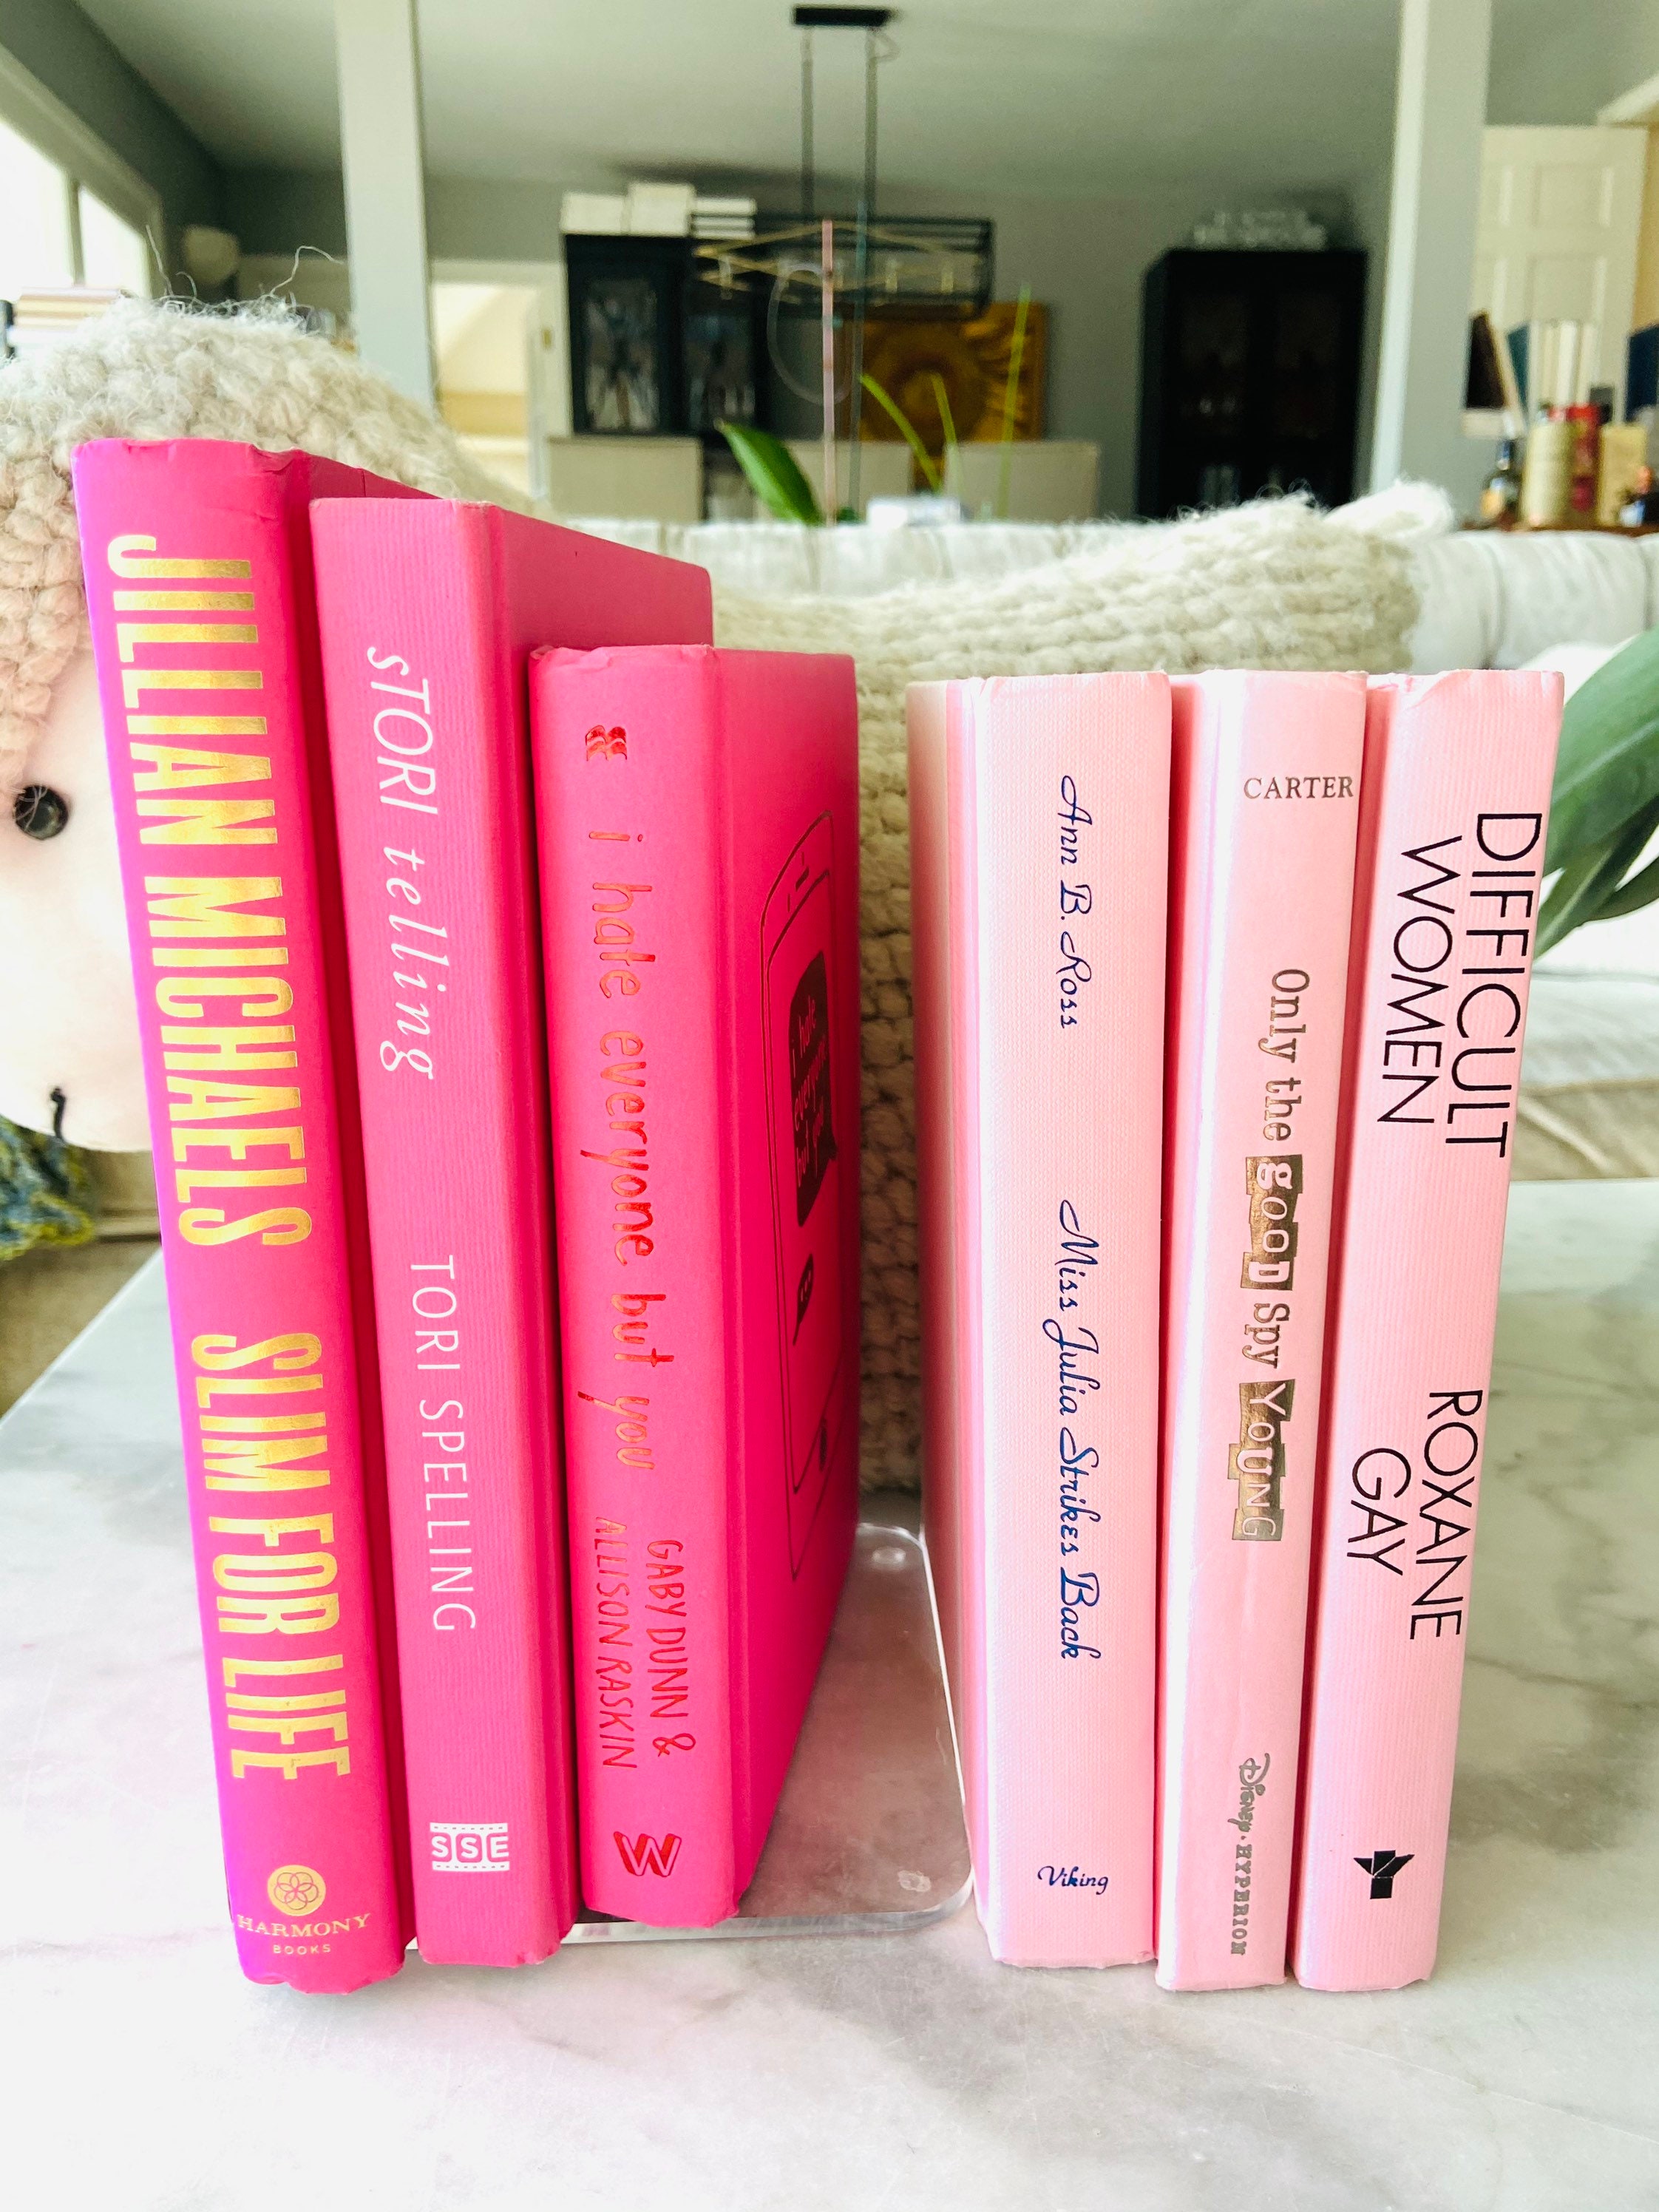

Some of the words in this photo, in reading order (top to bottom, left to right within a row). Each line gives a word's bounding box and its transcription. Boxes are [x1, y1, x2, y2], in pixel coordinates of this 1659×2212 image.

[107, 535, 278, 844] JILLIAN
[588, 831, 644, 842] i
[1057, 775, 1093, 865] Ann
[1244, 776, 1354, 799] CARTER
[592, 882, 656, 999] hate
[1060, 880, 1092, 920] B.
[380, 846, 450, 1080] telling
[1055, 931, 1092, 1028] Ross
[1377, 835, 1462, 1124] WOMEN
[1445, 812, 1542, 1158] DIFFICULT
[144, 876, 313, 1246] MICHAELS
[1258, 968, 1310, 1063] Only
[580, 1031, 654, 1266] everyone
[1263, 1077, 1303, 1141] the
[1054, 1199, 1099, 1312] Miss
[410, 1255, 461, 1371] TORI
[611, 1293, 674, 1368] but
[191, 1332, 331, 1492] SLIM
[1042, 1318, 1100, 1416] Julia
[577, 1391, 655, 1470] you
[419, 1399, 476, 1631] SPELLING
[1059, 1427, 1101, 1556] Strikes
[1347, 1448, 1411, 1575] GAY
[1410, 1390, 1483, 1640] ROXANE
[209, 1513, 340, 1635] FOR
[594, 1516, 633, 1647] ALLISON
[645, 1540, 688, 1618] GABY
[1060, 1566, 1102, 1660] Back
[223, 1654, 350, 1780] LIFE
[595, 1656, 637, 1768] RASKIN
[646, 1626, 689, 1719] DUNN
[652, 1733, 696, 1757] &
[1227, 1753, 1270, 1833] Disney
[613, 1831, 682, 1877] W
[1037, 1865, 1108, 1895] Viking
[1230, 1844, 1252, 1955] HYPERION
[237, 1913, 370, 1938] HARMONY
[273, 1944, 331, 1955] BOOKS
